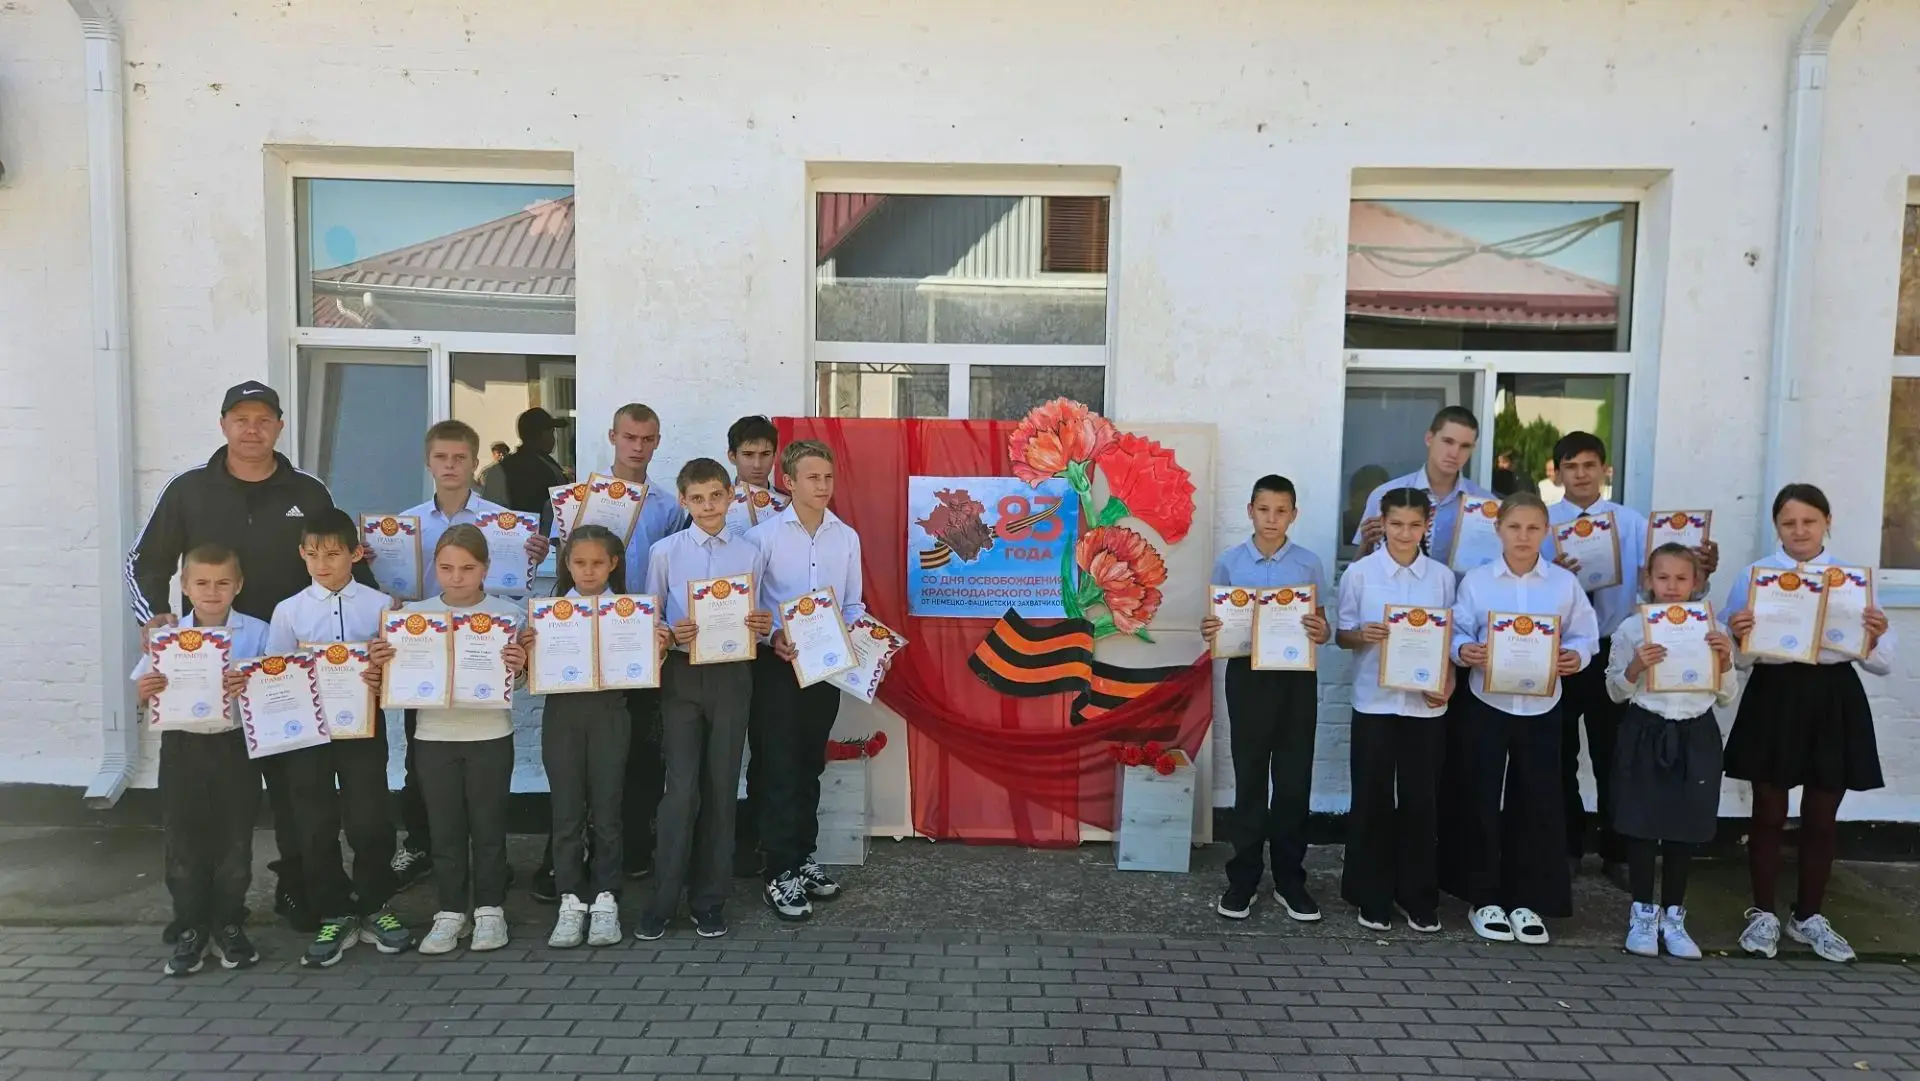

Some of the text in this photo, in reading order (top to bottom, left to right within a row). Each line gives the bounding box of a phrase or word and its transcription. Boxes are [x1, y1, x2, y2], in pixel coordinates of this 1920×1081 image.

[995, 495, 1064, 542] 83
[1004, 547, 1054, 562] ГОДА
[921, 575, 938, 584] СО
[940, 575, 965, 585] ДНЯ
[921, 588, 1032, 598] КРАСНОДАРСКОГО
[931, 599, 1017, 607] НЕМЕЦКО-ФАШИСТСКИХ
